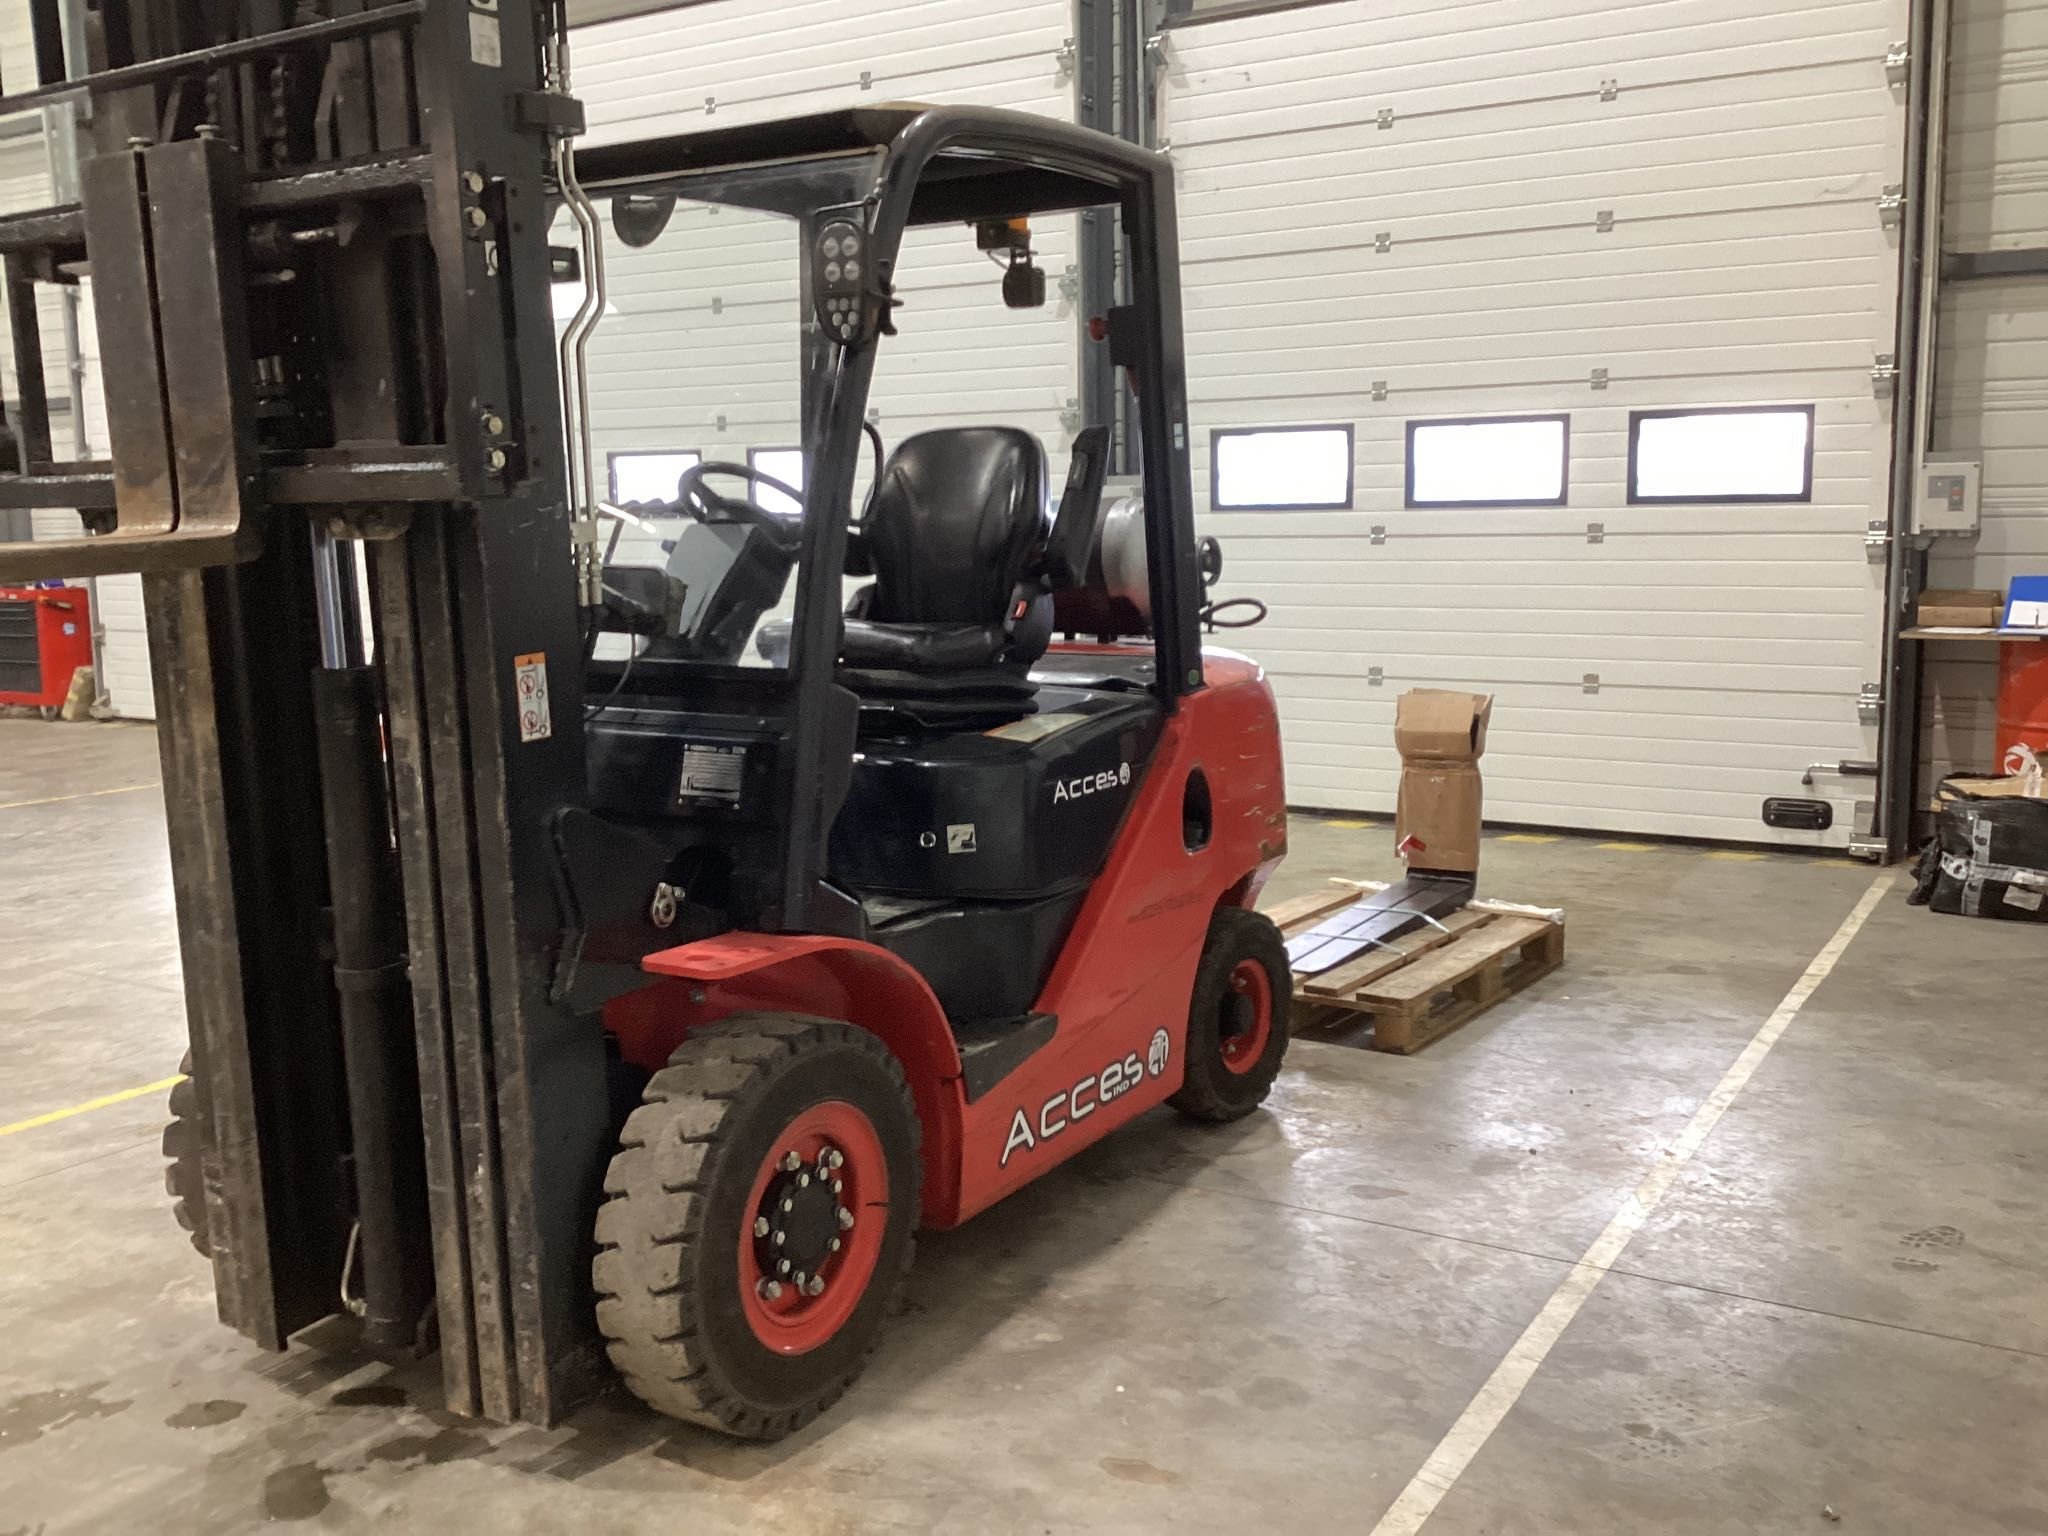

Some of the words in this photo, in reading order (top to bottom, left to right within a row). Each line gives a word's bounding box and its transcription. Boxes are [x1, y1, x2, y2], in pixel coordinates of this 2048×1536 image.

[1053, 769, 1118, 805] Acces
[1112, 1081, 1130, 1097] IND
[1001, 1053, 1144, 1164] Acces
